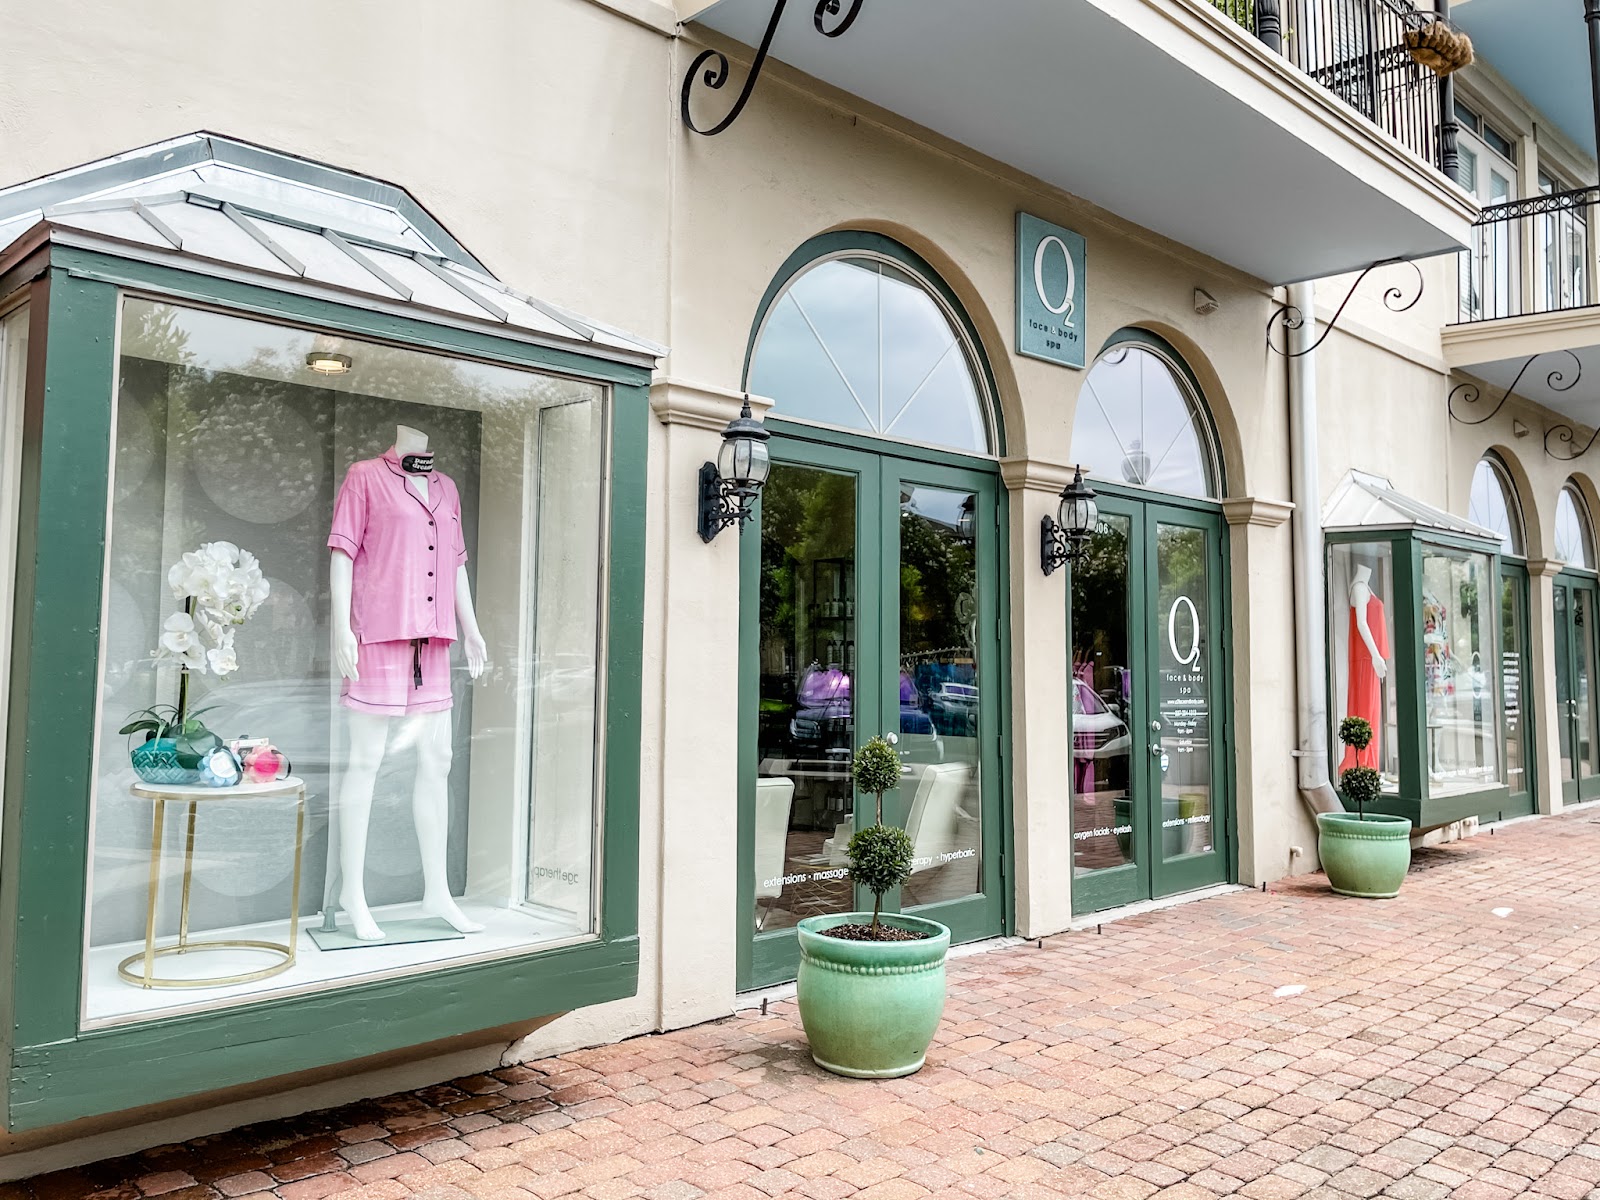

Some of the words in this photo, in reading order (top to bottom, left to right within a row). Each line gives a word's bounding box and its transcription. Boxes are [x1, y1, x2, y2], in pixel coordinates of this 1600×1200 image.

[1029, 319, 1048, 333] face
[1058, 327, 1078, 342] body
[1046, 339, 1061, 350] spa
[1166, 674, 1181, 682] face
[1188, 674, 1204, 683] body
[1073, 830, 1093, 840] oxygen
[1093, 827, 1110, 836] facials
[1113, 824, 1132, 836] eyelash
[763, 873, 806, 888] extensions
[813, 867, 849, 881] massage
[940, 848, 976, 862] hyperbaric
